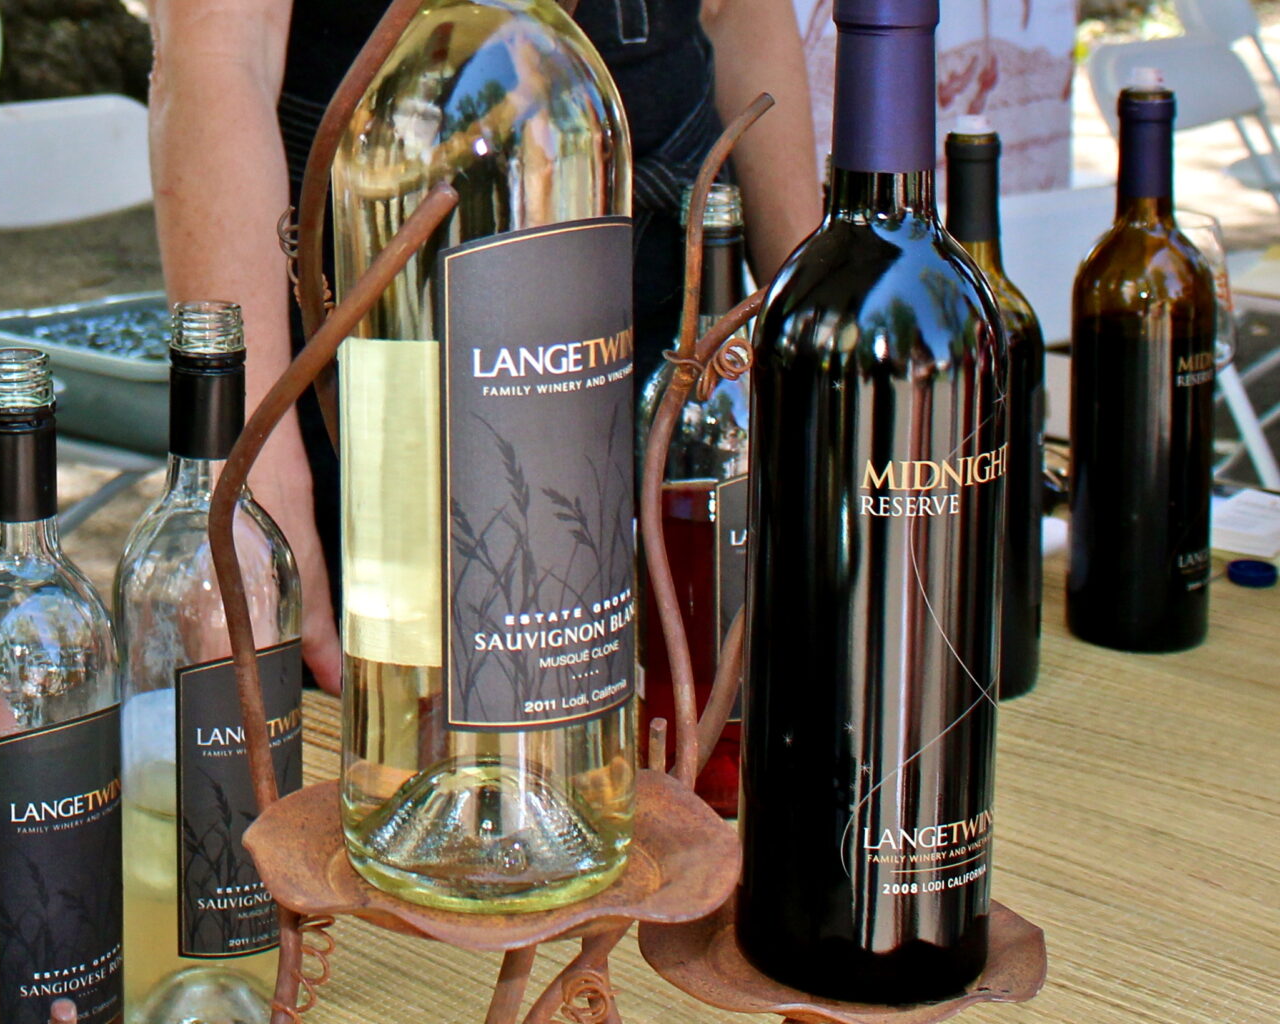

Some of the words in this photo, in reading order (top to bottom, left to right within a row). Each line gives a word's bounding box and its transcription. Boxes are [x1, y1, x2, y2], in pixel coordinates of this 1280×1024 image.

[482, 385, 532, 397] FAMILY
[536, 380, 582, 395] WINERY
[585, 375, 606, 389] AND
[860, 441, 1009, 491] MIDNIGHT
[860, 494, 960, 517] RESERVE
[504, 607, 583, 626] ESTATE
[592, 588, 632, 614] GROWN
[474, 619, 606, 651] SAUVIGNON
[591, 640, 620, 659] CLONE
[524, 699, 556, 714] 2011
[867, 854, 907, 864] FAMILY
[909, 851, 948, 864] WINERY
[949, 846, 967, 858] AND
[882, 883, 919, 895] 2008
[922, 879, 945, 893] LODI
[947, 863, 987, 889] CALIFORNIA
[20, 965, 106, 998] SANGIOVESE
